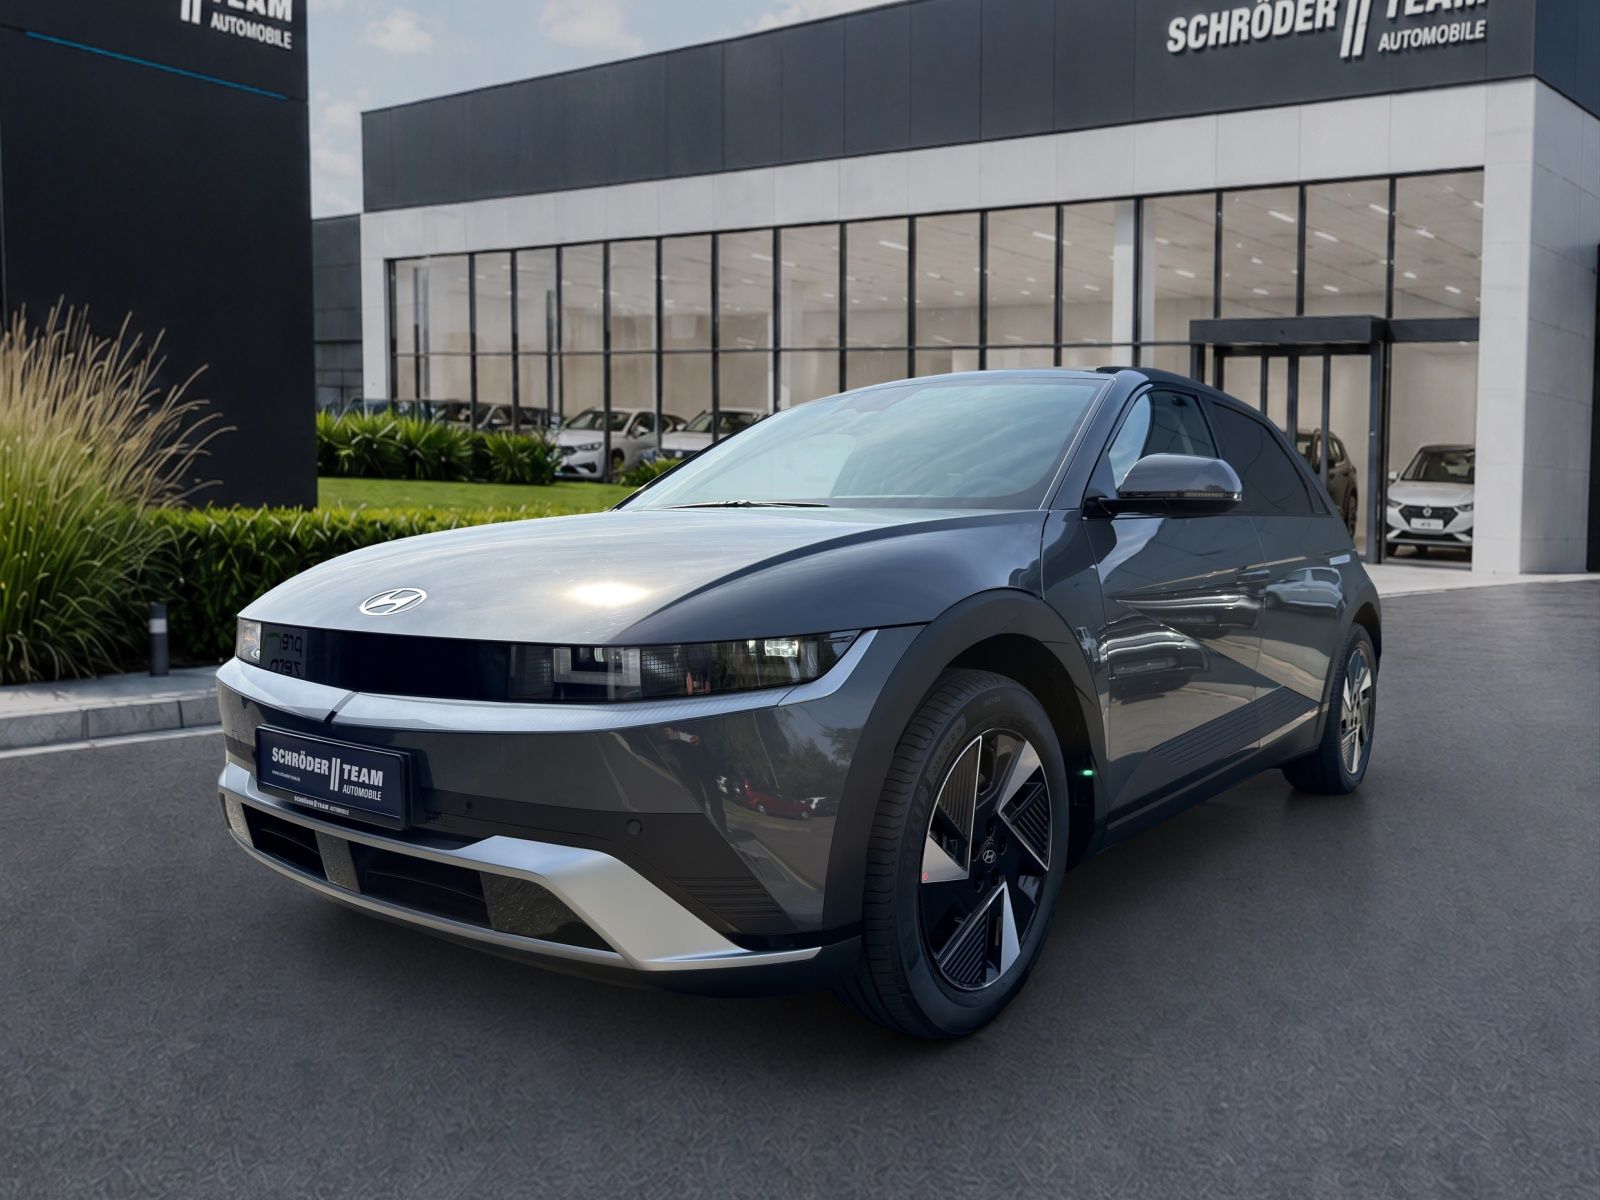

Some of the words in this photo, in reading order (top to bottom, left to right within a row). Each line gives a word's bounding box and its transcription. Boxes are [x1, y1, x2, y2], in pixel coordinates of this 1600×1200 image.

[210, 12, 292, 50] AUTOMOBILE
[1166, 0, 1338, 53] SCHRÖDER
[1378, 20, 1486, 52] AUTOMOBILE
[272, 747, 329, 775] SCHRÖDER
[342, 764, 384, 787] TEAM
[342, 784, 382, 801] AUTOMOBILE
